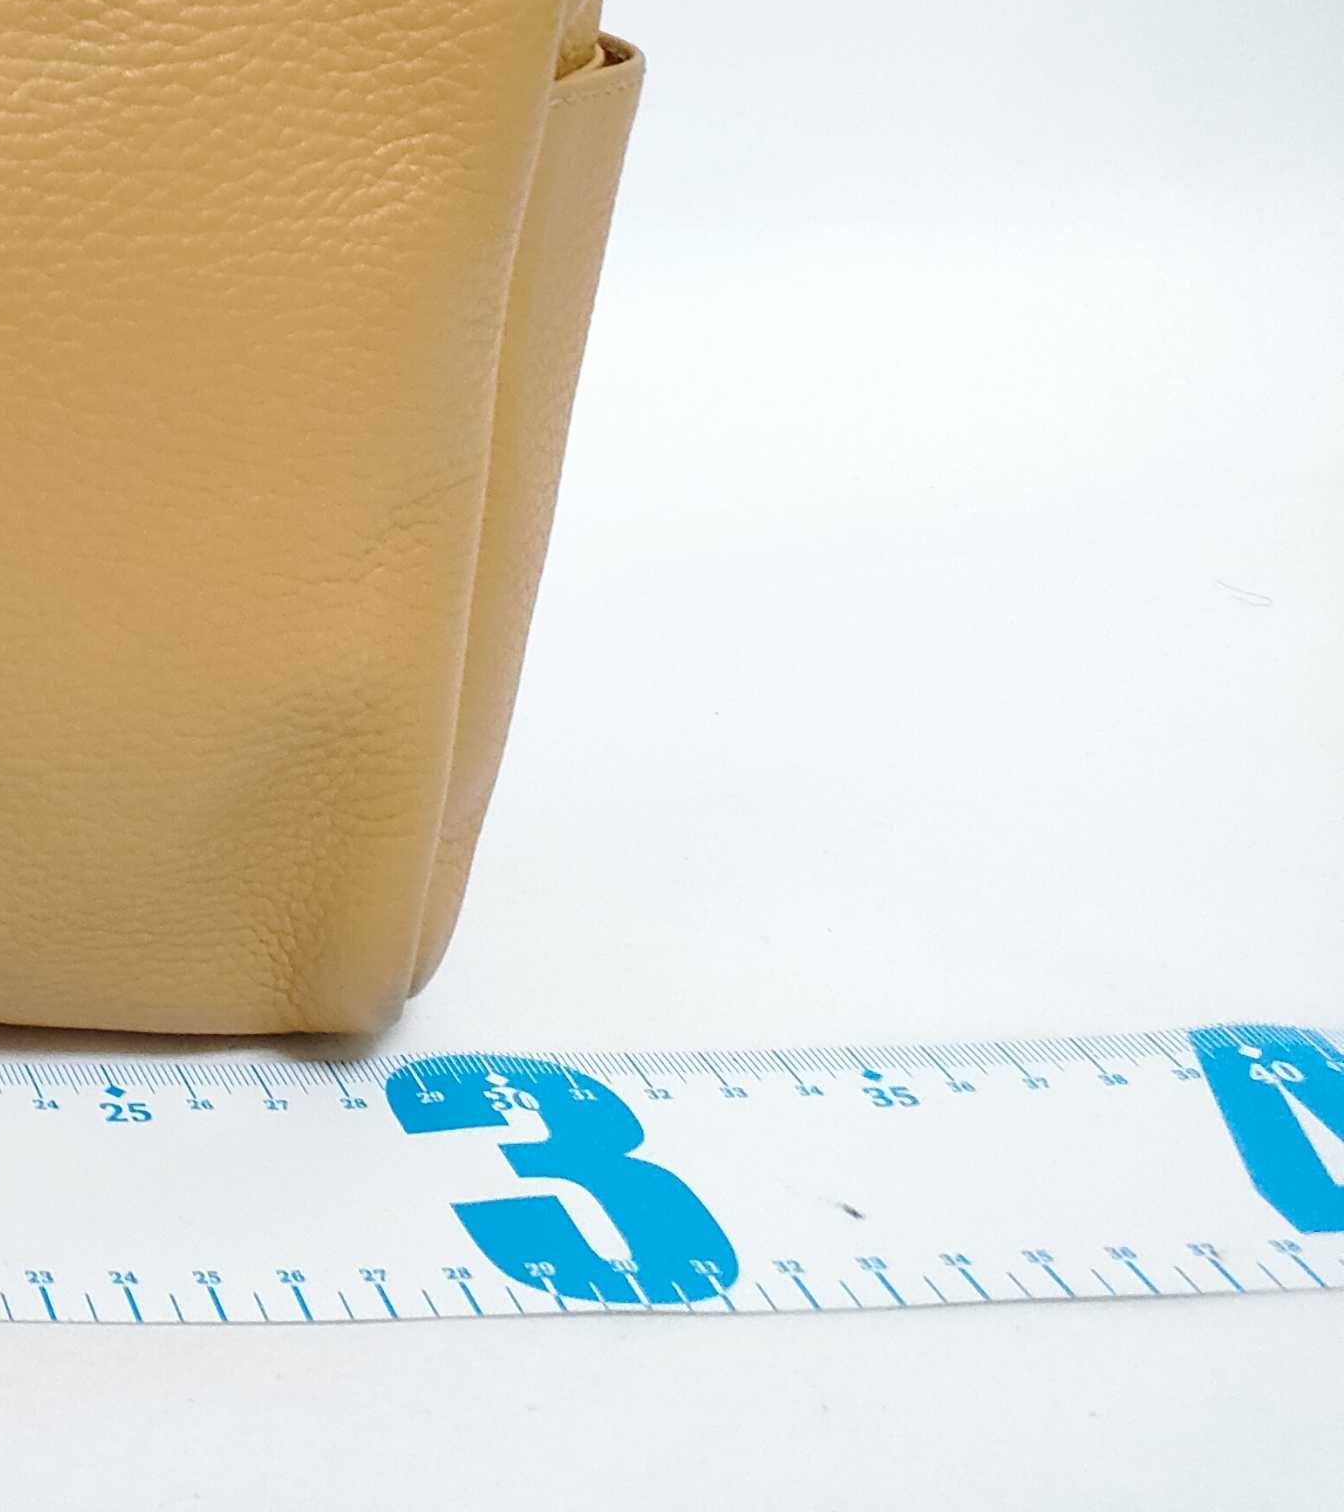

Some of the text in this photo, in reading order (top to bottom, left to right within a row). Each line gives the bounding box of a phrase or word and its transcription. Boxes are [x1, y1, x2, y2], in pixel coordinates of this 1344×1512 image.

[33, 1098, 60, 1109] 24
[100, 1103, 152, 1123] 25
[187, 1098, 214, 1110] 26
[264, 1099, 289, 1110] 27
[340, 1098, 367, 1110] 28
[417, 1091, 444, 1104] 29
[485, 1087, 540, 1112] 30
[569, 1089, 596, 1102] 31
[796, 1085, 823, 1097] 34
[863, 1086, 920, 1107] 35
[1249, 1061, 1306, 1084] 40
[386, 1054, 739, 1304] 3
[25, 1270, 54, 1283] 23
[109, 1270, 140, 1284] 24
[193, 1270, 222, 1284] 25
[276, 1269, 306, 1283] 26
[359, 1267, 387, 1281] 27
[442, 1266, 472, 1280] 28
[523, 1261, 556, 1277] 29
[938, 1253, 972, 1268] 34
